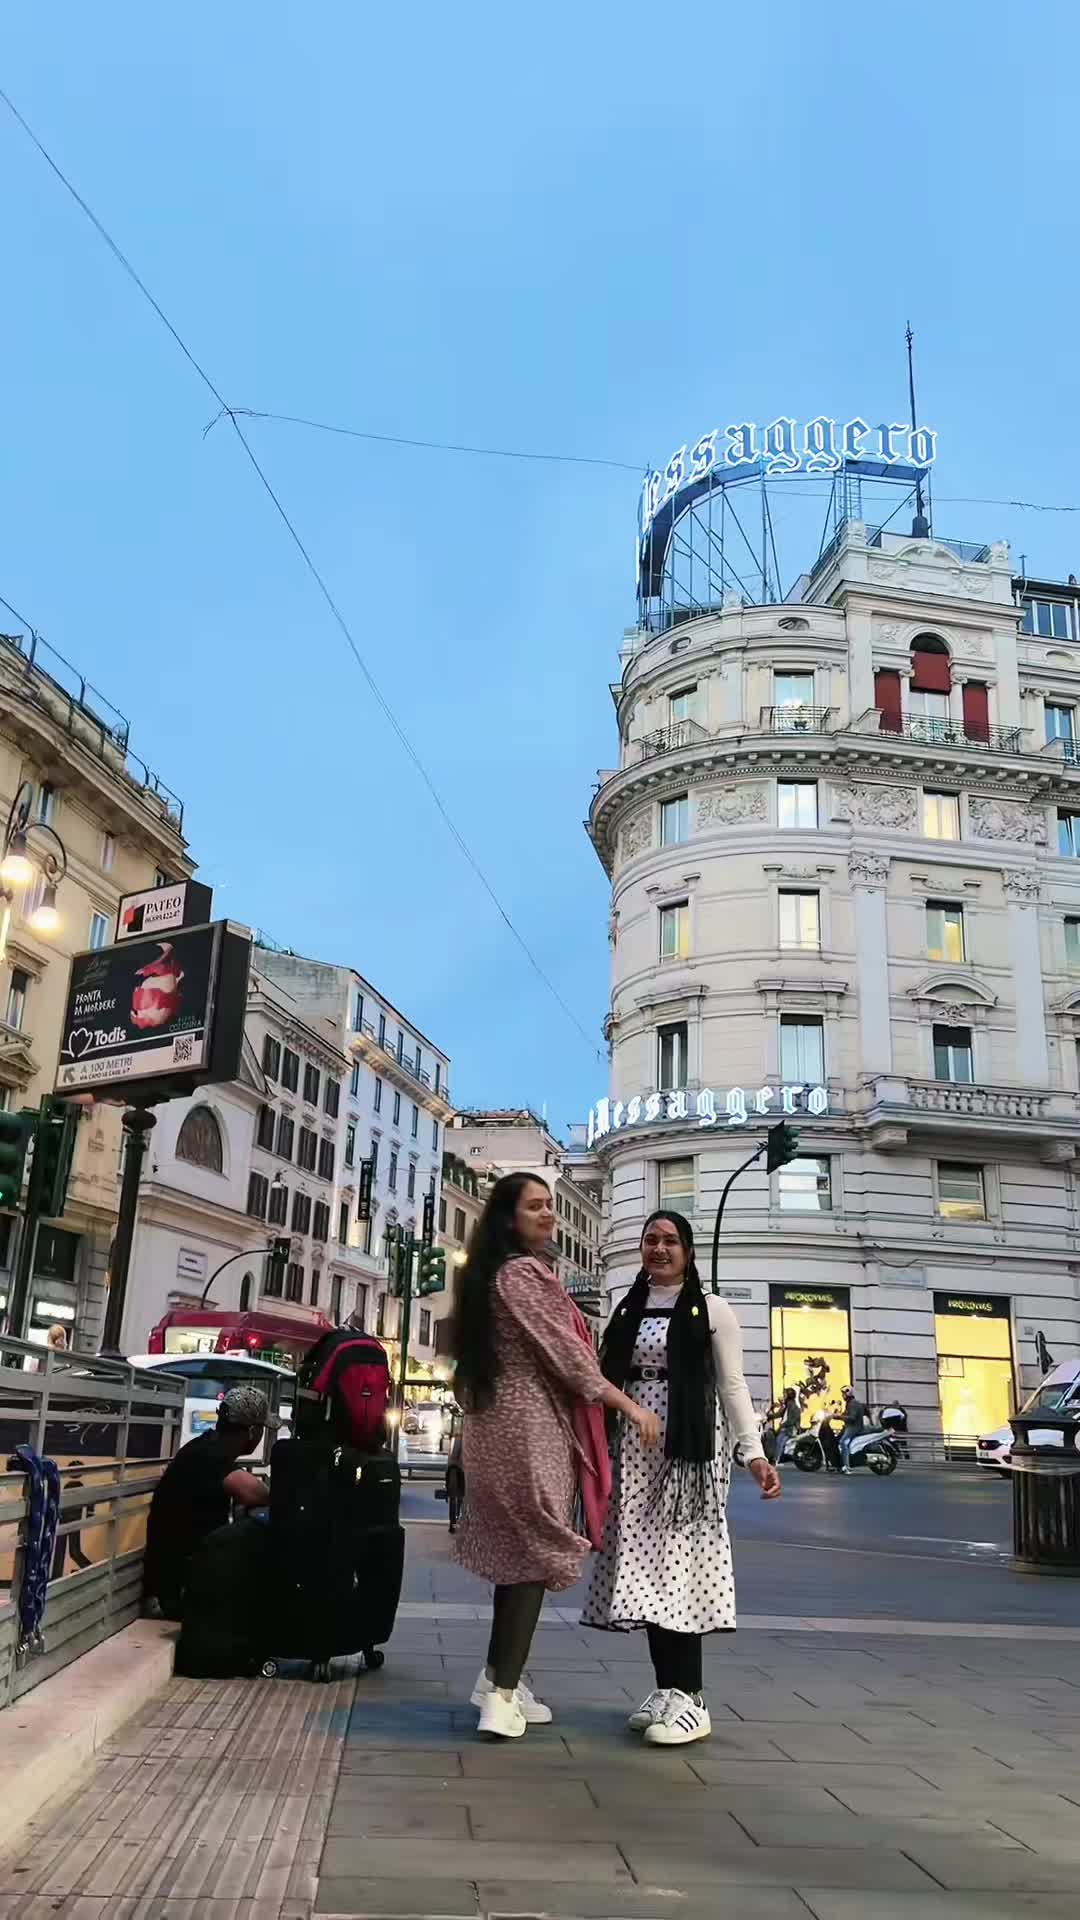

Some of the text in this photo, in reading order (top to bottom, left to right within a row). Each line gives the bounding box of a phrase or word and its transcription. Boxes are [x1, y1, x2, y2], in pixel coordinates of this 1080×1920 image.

[94, 1026, 127, 1046] Todis
[91, 1062, 105, 1072] 100
[105, 1056, 133, 1070] METRI
